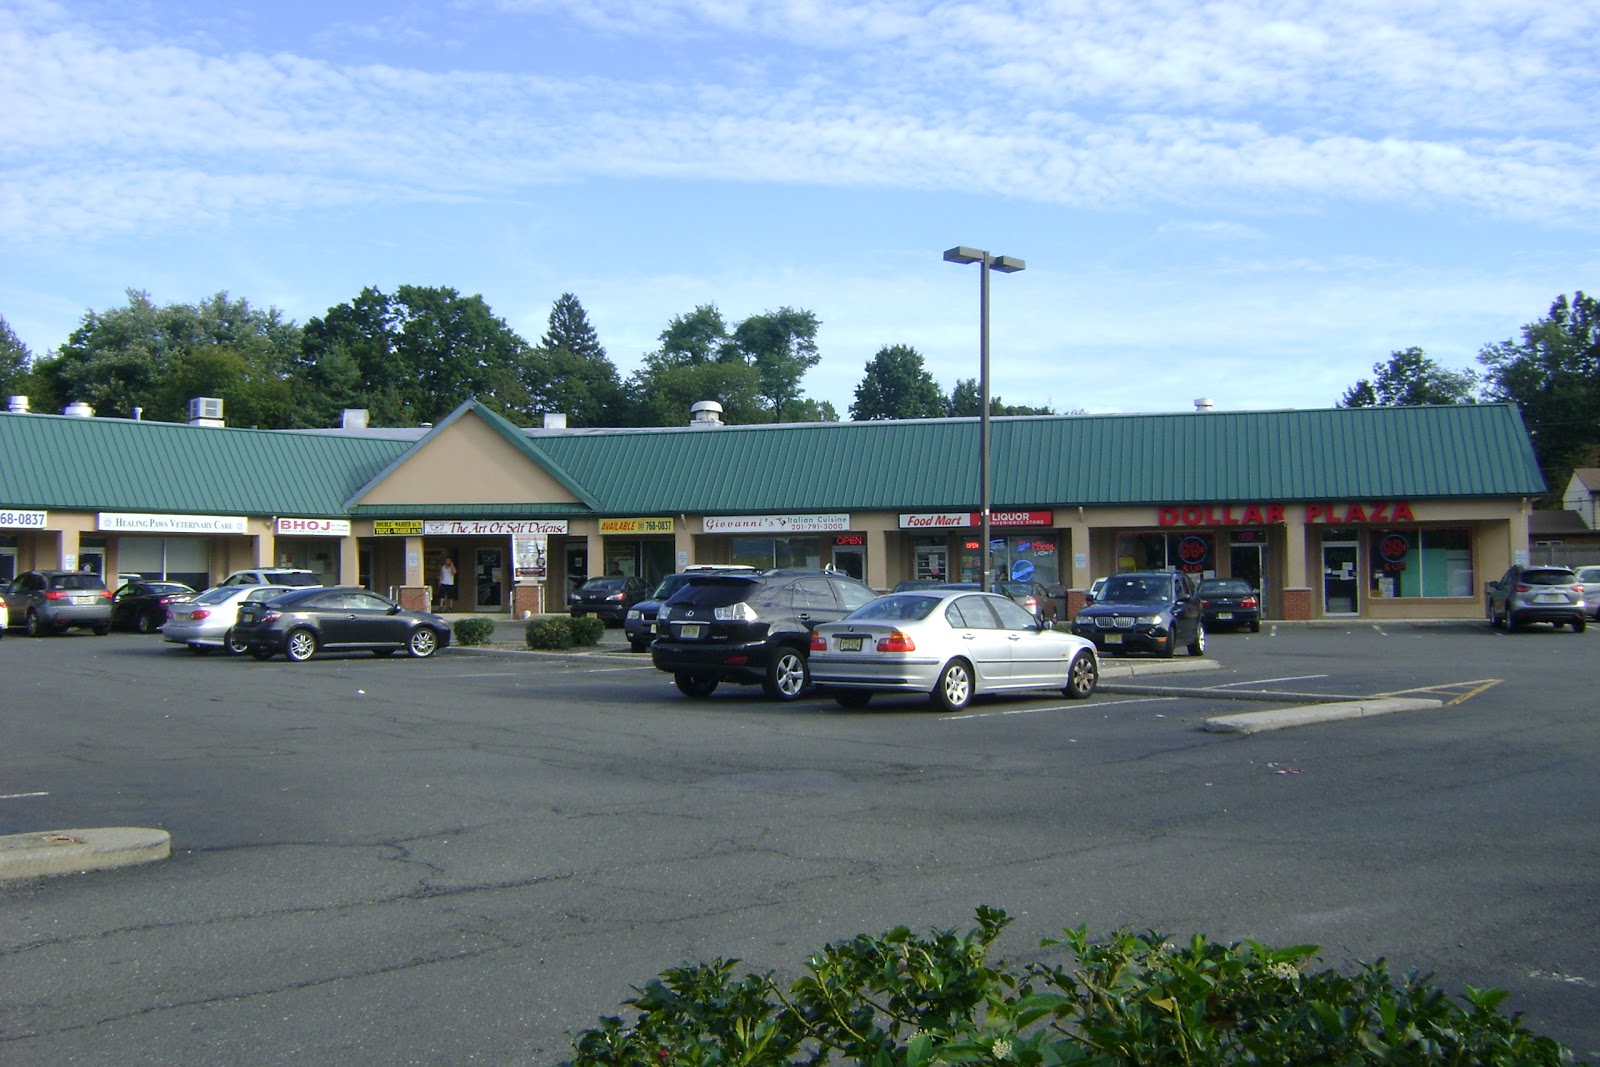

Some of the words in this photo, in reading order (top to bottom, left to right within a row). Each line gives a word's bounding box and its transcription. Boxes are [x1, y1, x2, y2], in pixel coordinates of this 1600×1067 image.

[0, 513, 45, 525] 68-0837
[992, 513, 1029, 521] LIQUOR
[1158, 504, 1285, 526] DOLLAR
[1304, 502, 1415, 523] PLAZA
[280, 520, 330, 531] BHOJ
[601, 521, 636, 531] AVAILABLE
[646, 521, 672, 531] 768-0837
[705, 518, 774, 529] Giovanni's
[907, 515, 934, 526] Food
[934, 515, 962, 526] Mart
[450, 522, 468, 534] The
[469, 522, 488, 534] Art
[490, 522, 503, 534] Of
[507, 522, 526, 534] Self
[528, 523, 566, 534] Defense
[836, 536, 862, 545] OPEN
